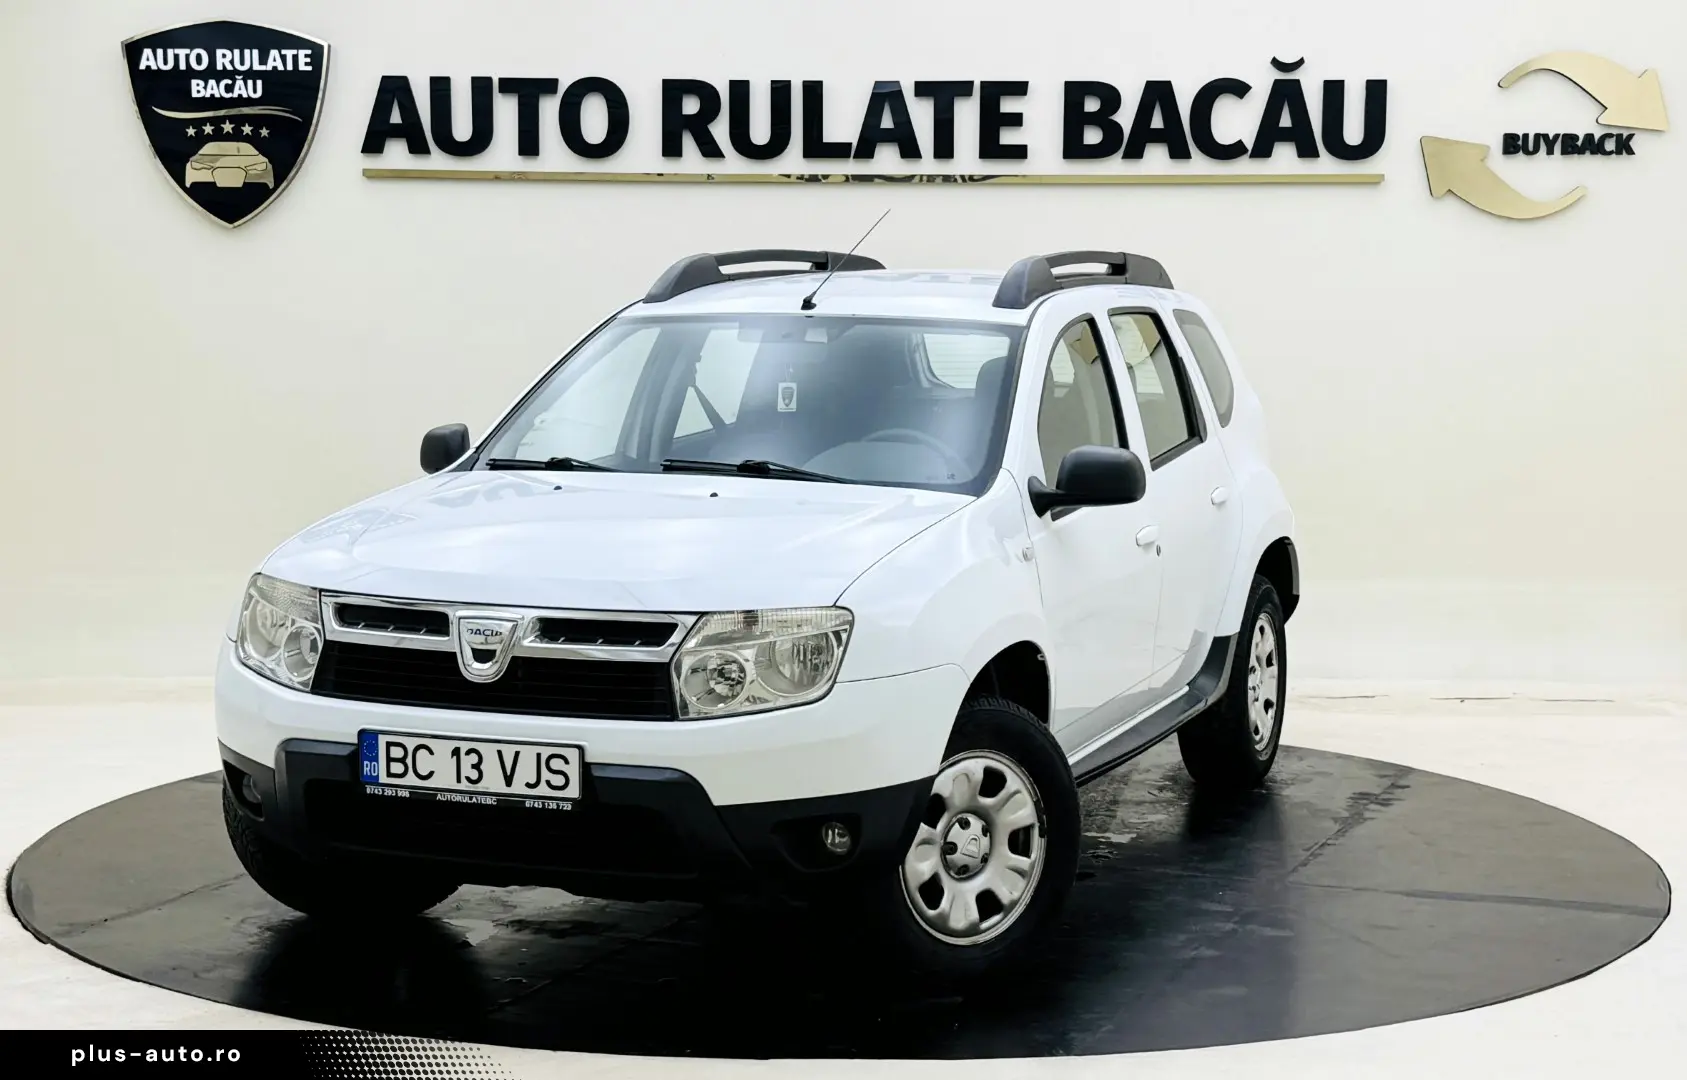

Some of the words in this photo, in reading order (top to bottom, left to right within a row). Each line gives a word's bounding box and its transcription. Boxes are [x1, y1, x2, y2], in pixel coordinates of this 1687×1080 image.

[139, 48, 209, 72] AUTO
[215, 47, 313, 72] RULATE
[190, 75, 263, 99] BACĂU
[361, 75, 630, 159] AUTO
[661, 78, 1030, 160] RULATE
[1062, 56, 1388, 162] BACĂU
[1502, 132, 1636, 157] BUYBACK
[363, 760, 379, 777] RO
[385, 740, 436, 781] BC
[450, 746, 484, 785] 13
[496, 749, 571, 792] VJS
[436, 793, 498, 806] AUTORULATEBC
